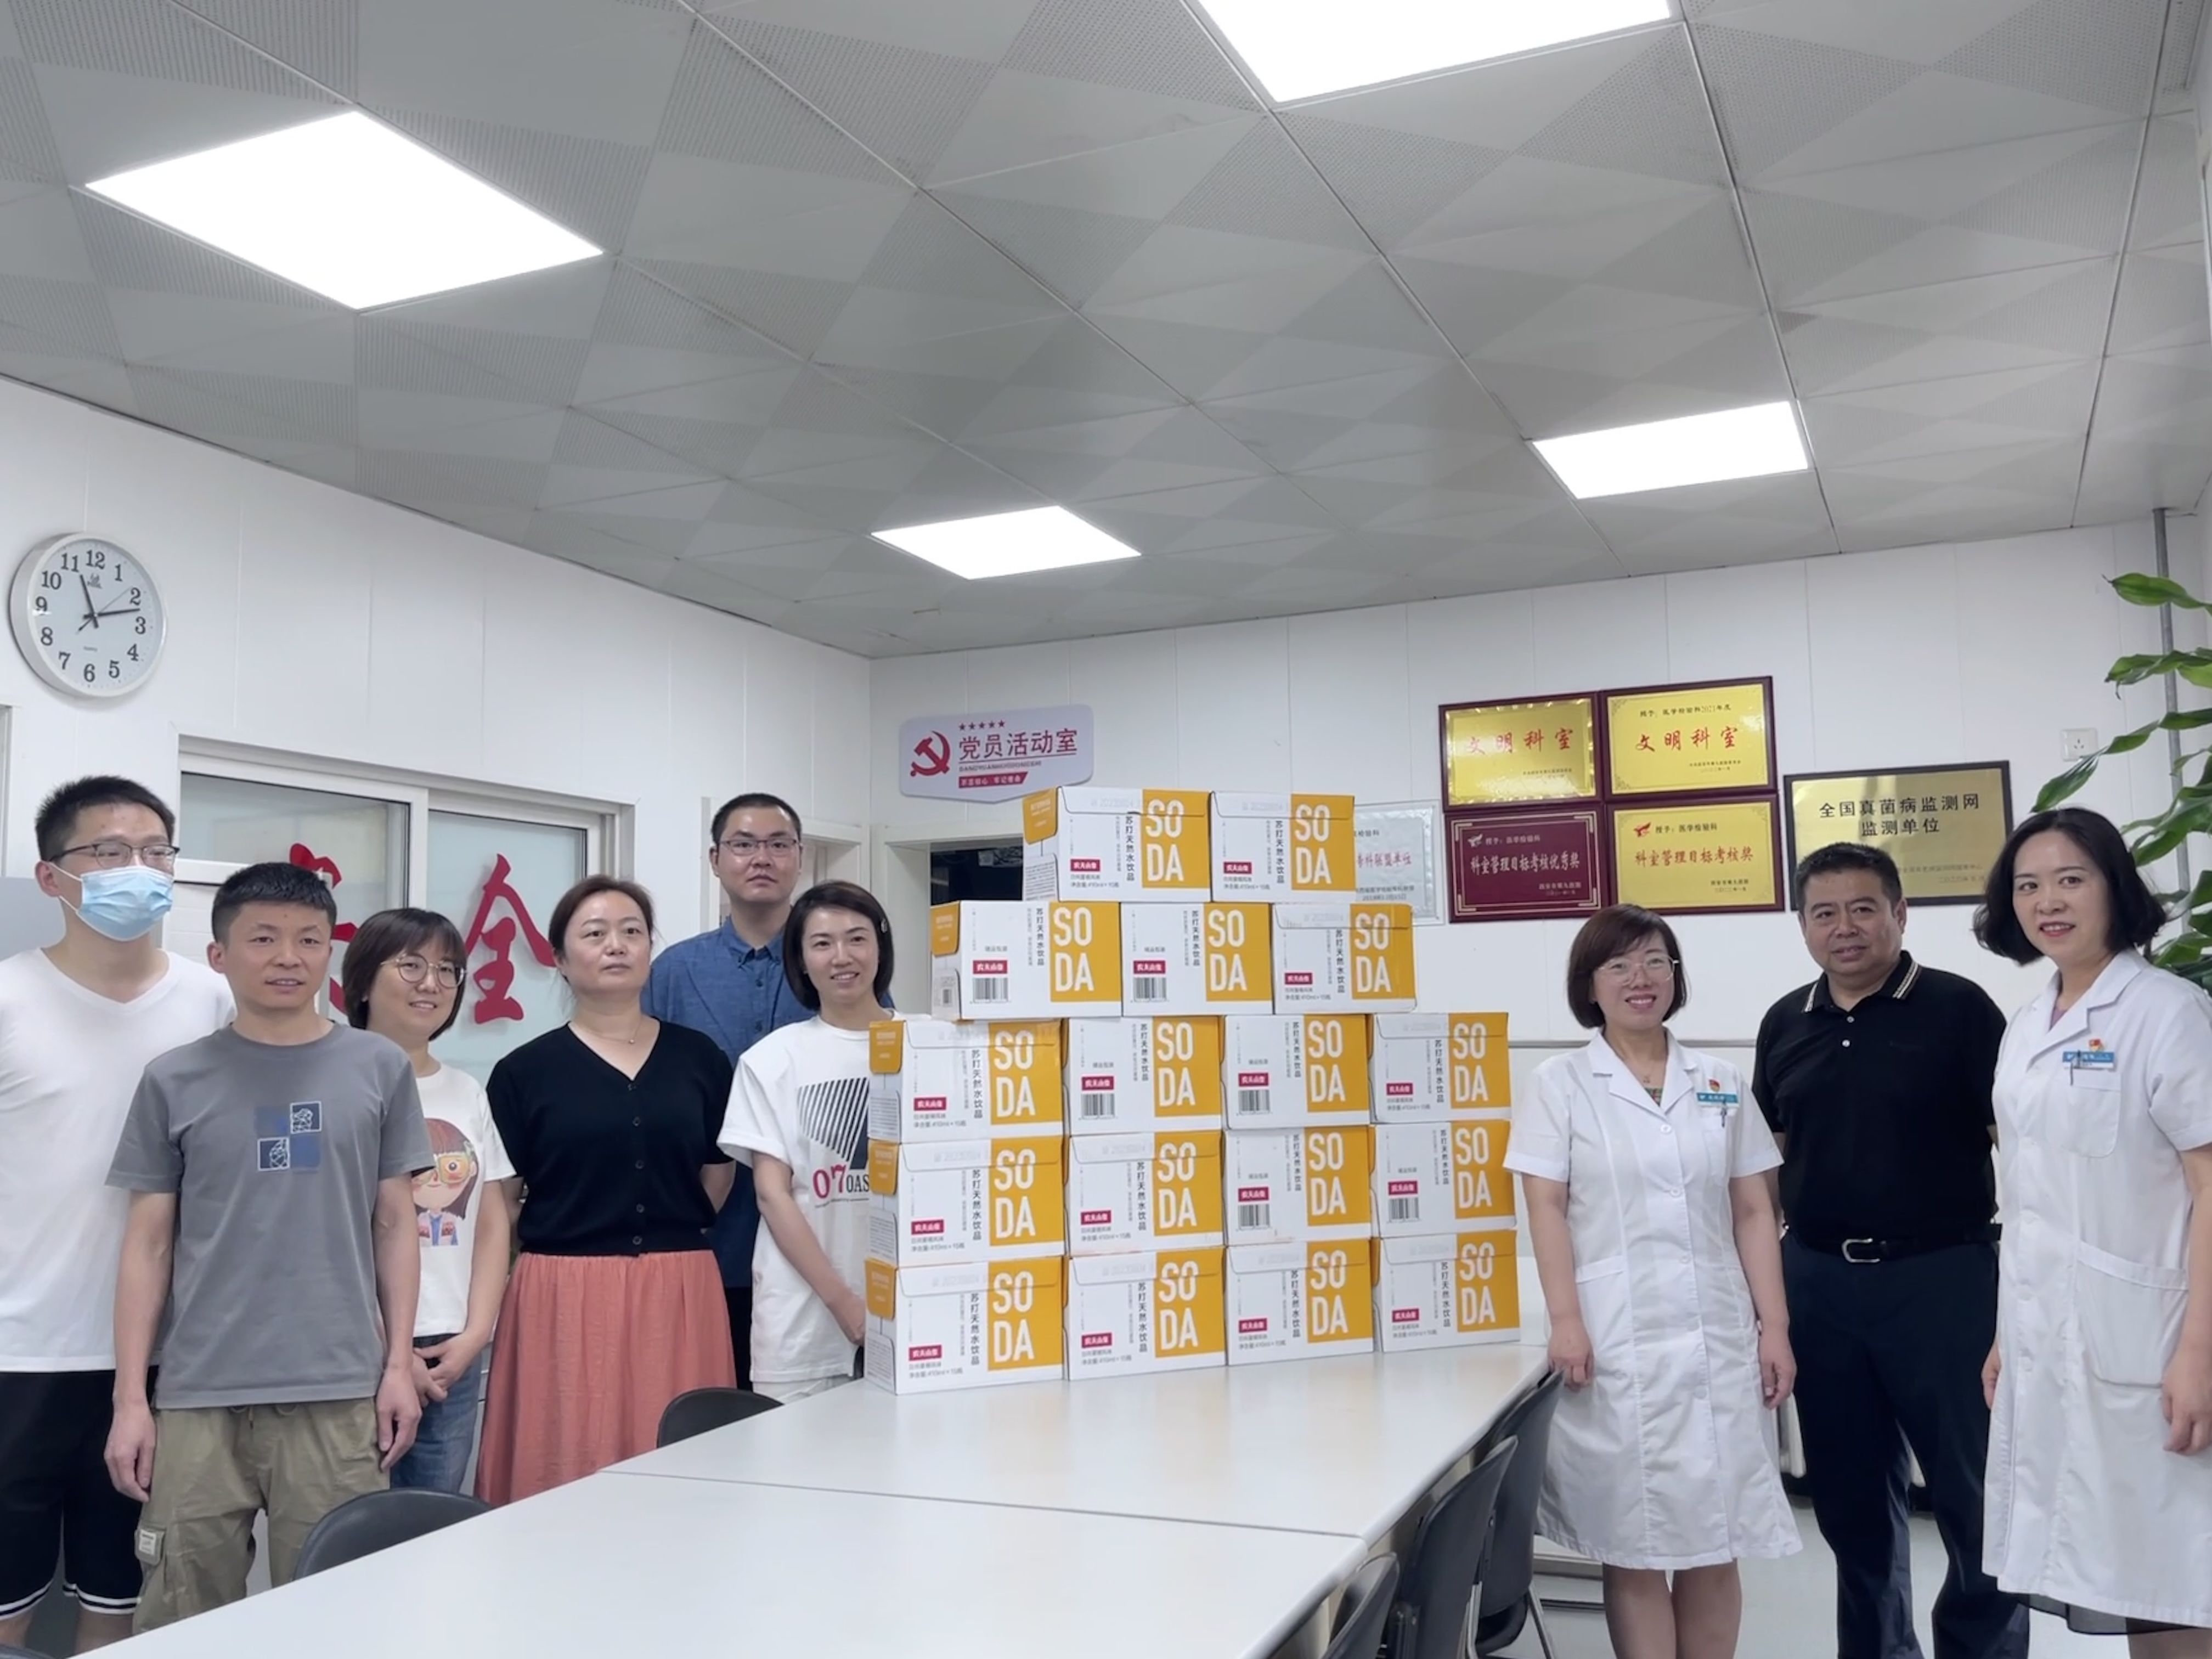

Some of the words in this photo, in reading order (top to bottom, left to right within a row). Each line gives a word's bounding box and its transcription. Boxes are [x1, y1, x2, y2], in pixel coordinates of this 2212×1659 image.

[60, 552, 80, 573] 11
[86, 550, 105, 569] 12
[115, 564, 122, 582] 1
[42, 570, 61, 590] 10
[129, 587, 142, 606] 2
[35, 596, 48, 612] 9
[41, 627, 53, 646] 8
[135, 616, 146, 635] 3
[59, 651, 71, 670] 7
[84, 663, 95, 682] 6
[109, 659, 120, 679] 5
[127, 644, 139, 661] 4
[960, 728, 1077, 760] 党员活动室
[1468, 727, 1573, 754] 文明科室
[1635, 726, 1738, 752] 文明科室
[1146, 799, 1184, 838] SO
[1295, 804, 1330, 841] SO
[1819, 793, 1979, 818] 全国真菌病监测网
[1861, 817, 1940, 836] 监测单位
[1126, 816, 1135, 881] 苏打天然水饮品
[1147, 843, 1184, 882] DA
[1275, 820, 1284, 884] 苏打天然水饮品
[1296, 847, 1332, 884] DA
[1470, 850, 1580, 876] 科室管理目标考核优秀奖
[1635, 845, 1753, 868] 科室管理目标考核奖
[465, 853, 558, 1025] 全
[1036, 908, 1045, 966] 苏打天然水饮品
[1053, 907, 1093, 947] SO
[1192, 910, 1200, 966] 苏打天然水饮品
[1208, 909, 1245, 948] SO
[1354, 912, 1390, 951] SO
[1054, 952, 1095, 992] DA
[1210, 953, 1248, 992] DA
[1335, 929, 1345, 994] 苏打天然水饮品
[1356, 956, 1392, 993] DA
[994, 1030, 1035, 1070] SO
[1140, 1023, 1149, 1081] 苏打天然水饮品
[1156, 1022, 1194, 1062] SO
[1293, 1022, 1301, 1078] 苏打天然水饮品
[1308, 1020, 1343, 1058] SO
[1453, 1022, 1487, 1060] SO
[971, 1049, 983, 1119] 苏打天然水饮品
[1158, 1066, 1196, 1107] DA
[1310, 1064, 1346, 1103] DA
[1435, 1040, 1444, 1103] 苏打天然水饮品
[1454, 1064, 1489, 1103] DA
[996, 1075, 1036, 1118] DA
[1157, 1142, 1197, 1183] SO
[1293, 1134, 1302, 1192] 苏打天然水饮品
[1308, 1132, 1344, 1171] SO
[1441, 1130, 1449, 1185] 苏打天然水饮品
[1455, 1126, 1490, 1165] SO
[994, 1148, 1036, 1192] SO
[1457, 1170, 1493, 1209] DA
[972, 1169, 981, 1241] 苏打天然水饮品
[1137, 1161, 1147, 1231] 苏打天然水饮品
[1158, 1187, 1198, 1229] DA
[1310, 1176, 1347, 1216] DA
[995, 1196, 1036, 1239] DA
[1158, 1260, 1199, 1303] SO
[1310, 1249, 1347, 1290] SO
[1459, 1242, 1496, 1282] SO
[992, 1270, 1034, 1314] SO
[1291, 1269, 1300, 1338] 苏打天然水饮品
[1441, 1262, 1451, 1328] 苏打天然水饮品
[1461, 1285, 1496, 1325] DA
[970, 1293, 980, 1365] 苏打天然水饮品
[1138, 1282, 1148, 1353] 苏打天然水饮品
[1160, 1307, 1199, 1351] DA
[1312, 1294, 1349, 1336] DA
[993, 1318, 1035, 1363] DA
